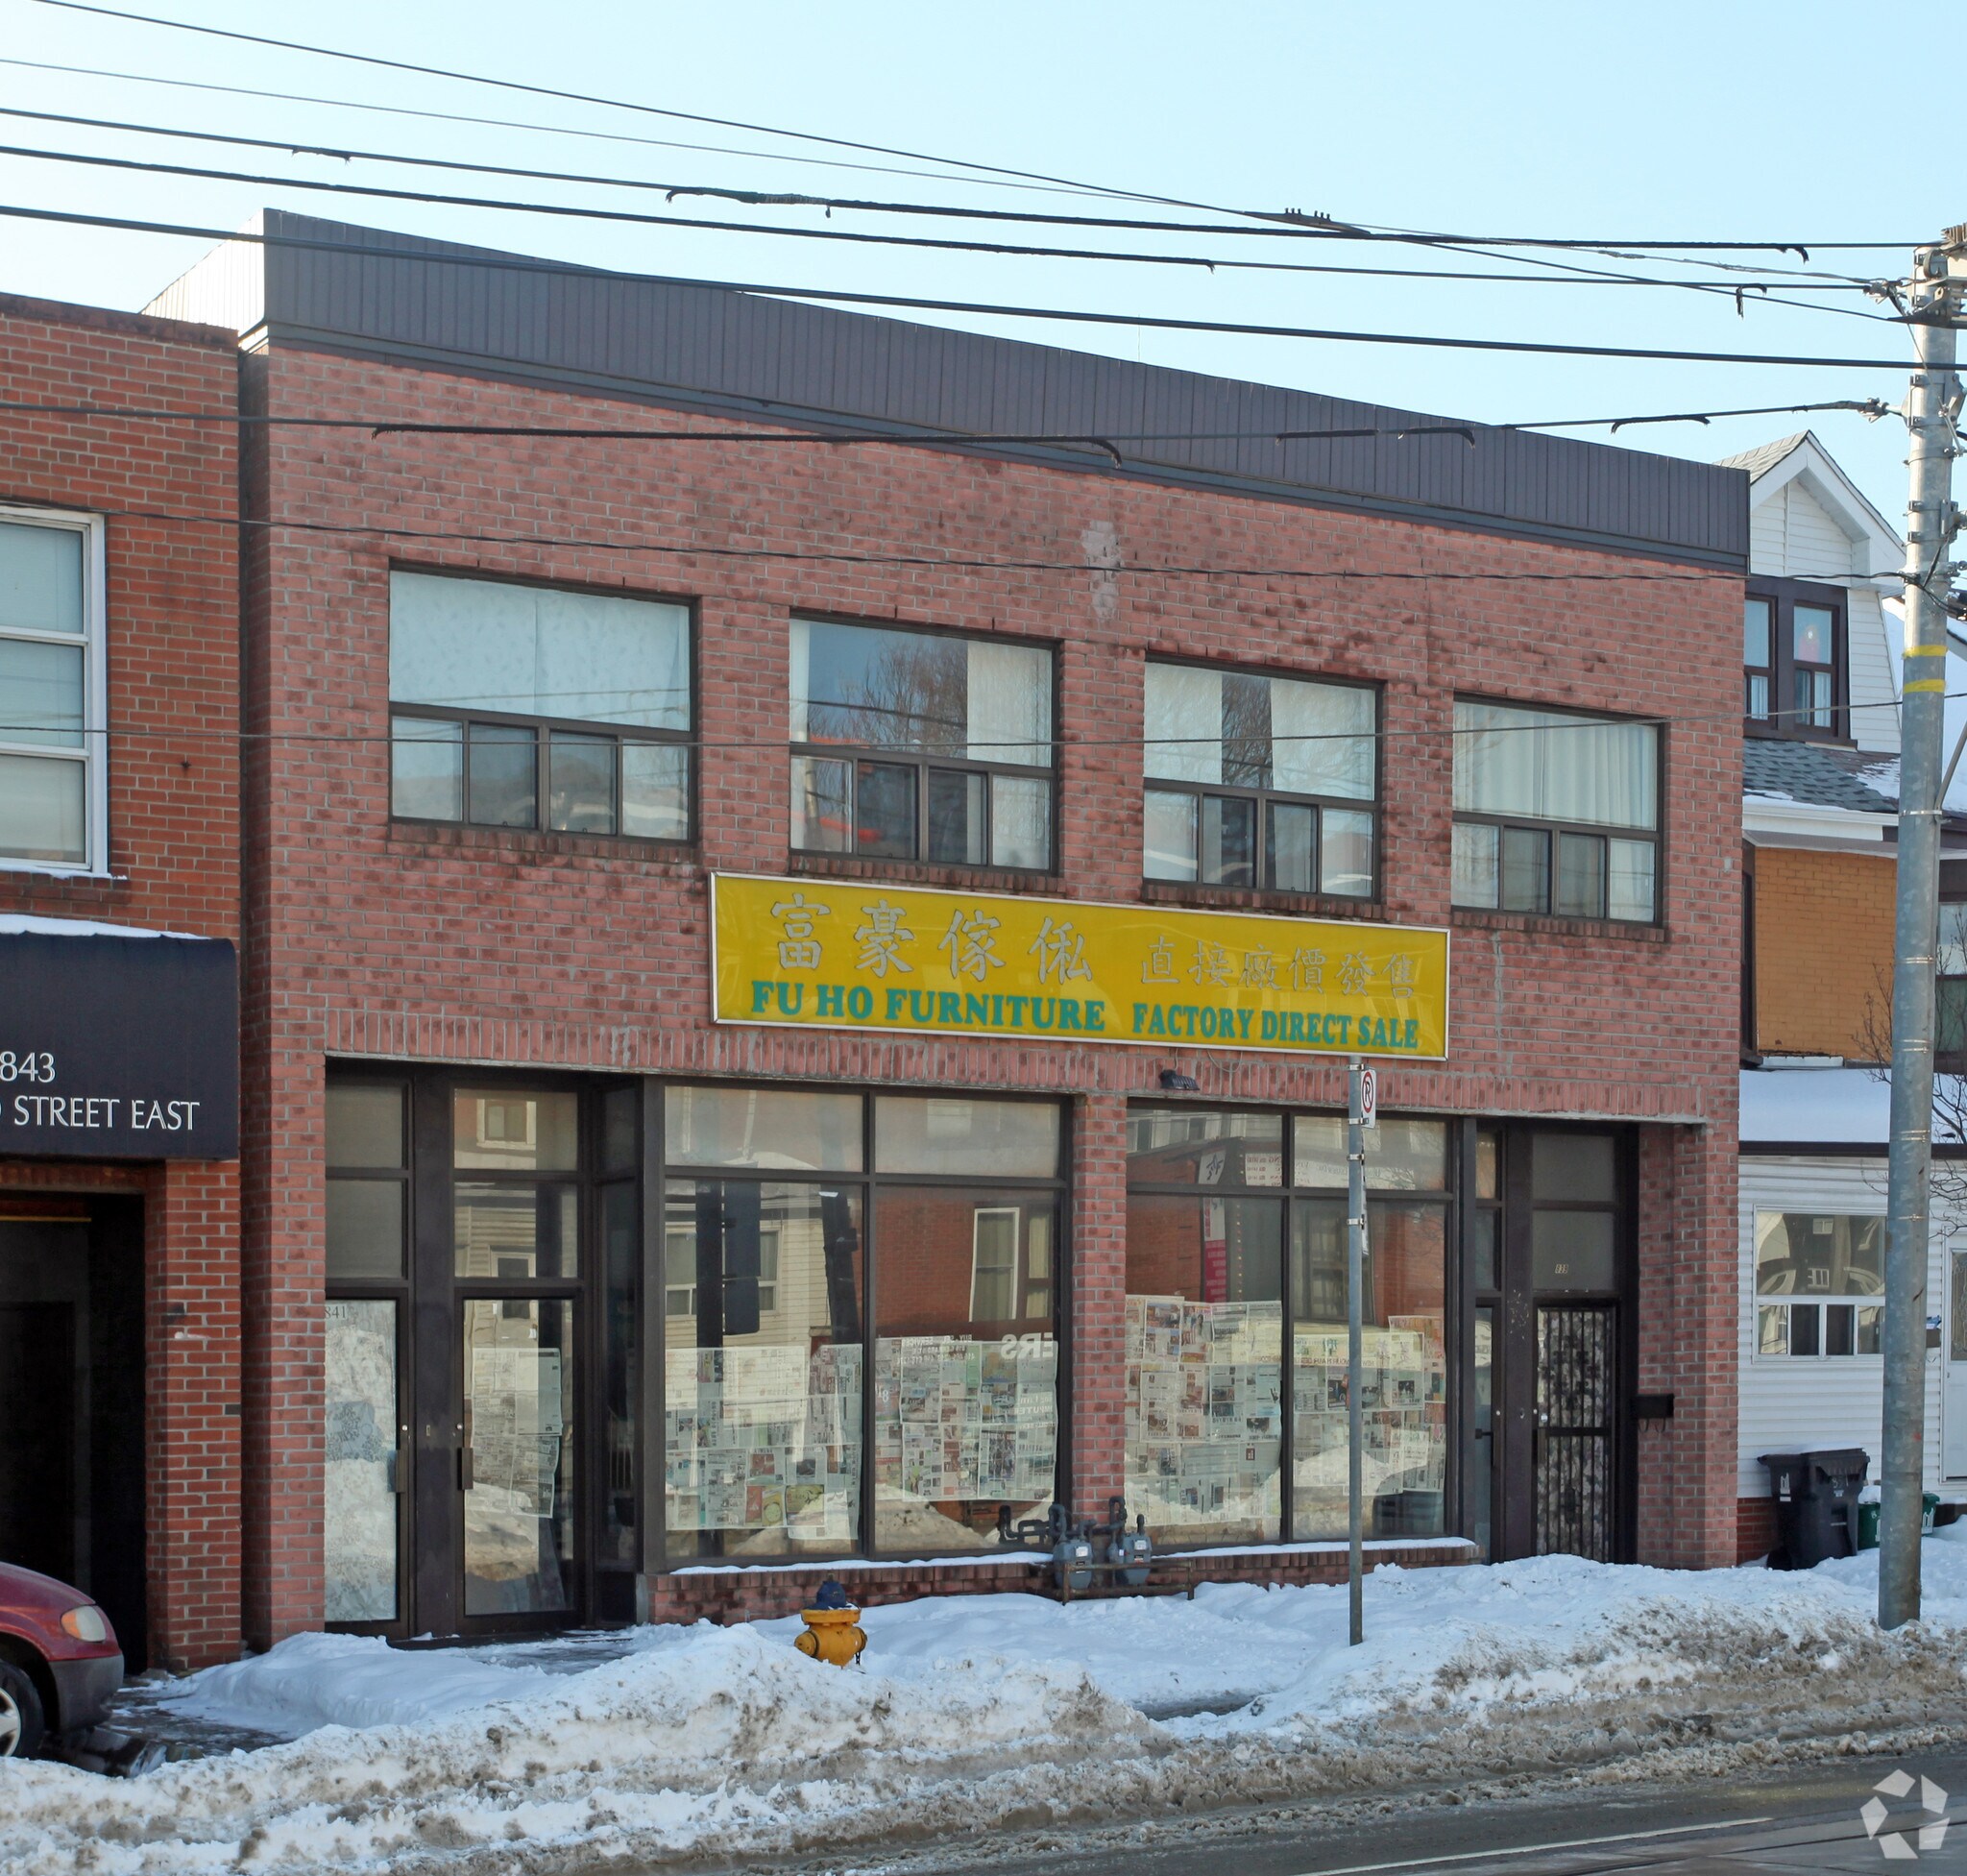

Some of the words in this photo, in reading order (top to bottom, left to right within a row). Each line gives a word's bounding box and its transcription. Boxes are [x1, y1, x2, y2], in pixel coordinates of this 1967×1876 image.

[769, 891, 1093, 985] 富豪傢俬
[1140, 934, 1416, 1000] 直接廠價發售
[751, 979, 804, 1016] FU
[815, 984, 874, 1020] HO
[885, 988, 1106, 1033] FURNITURE
[1131, 1002, 1255, 1040] FACTORY
[1261, 1010, 1354, 1045] DIRECT
[1357, 1015, 1420, 1050] SALE
[13, 1094, 120, 1129] STREET
[131, 1099, 200, 1131] EAST
[325, 1305, 346, 1319] 841
